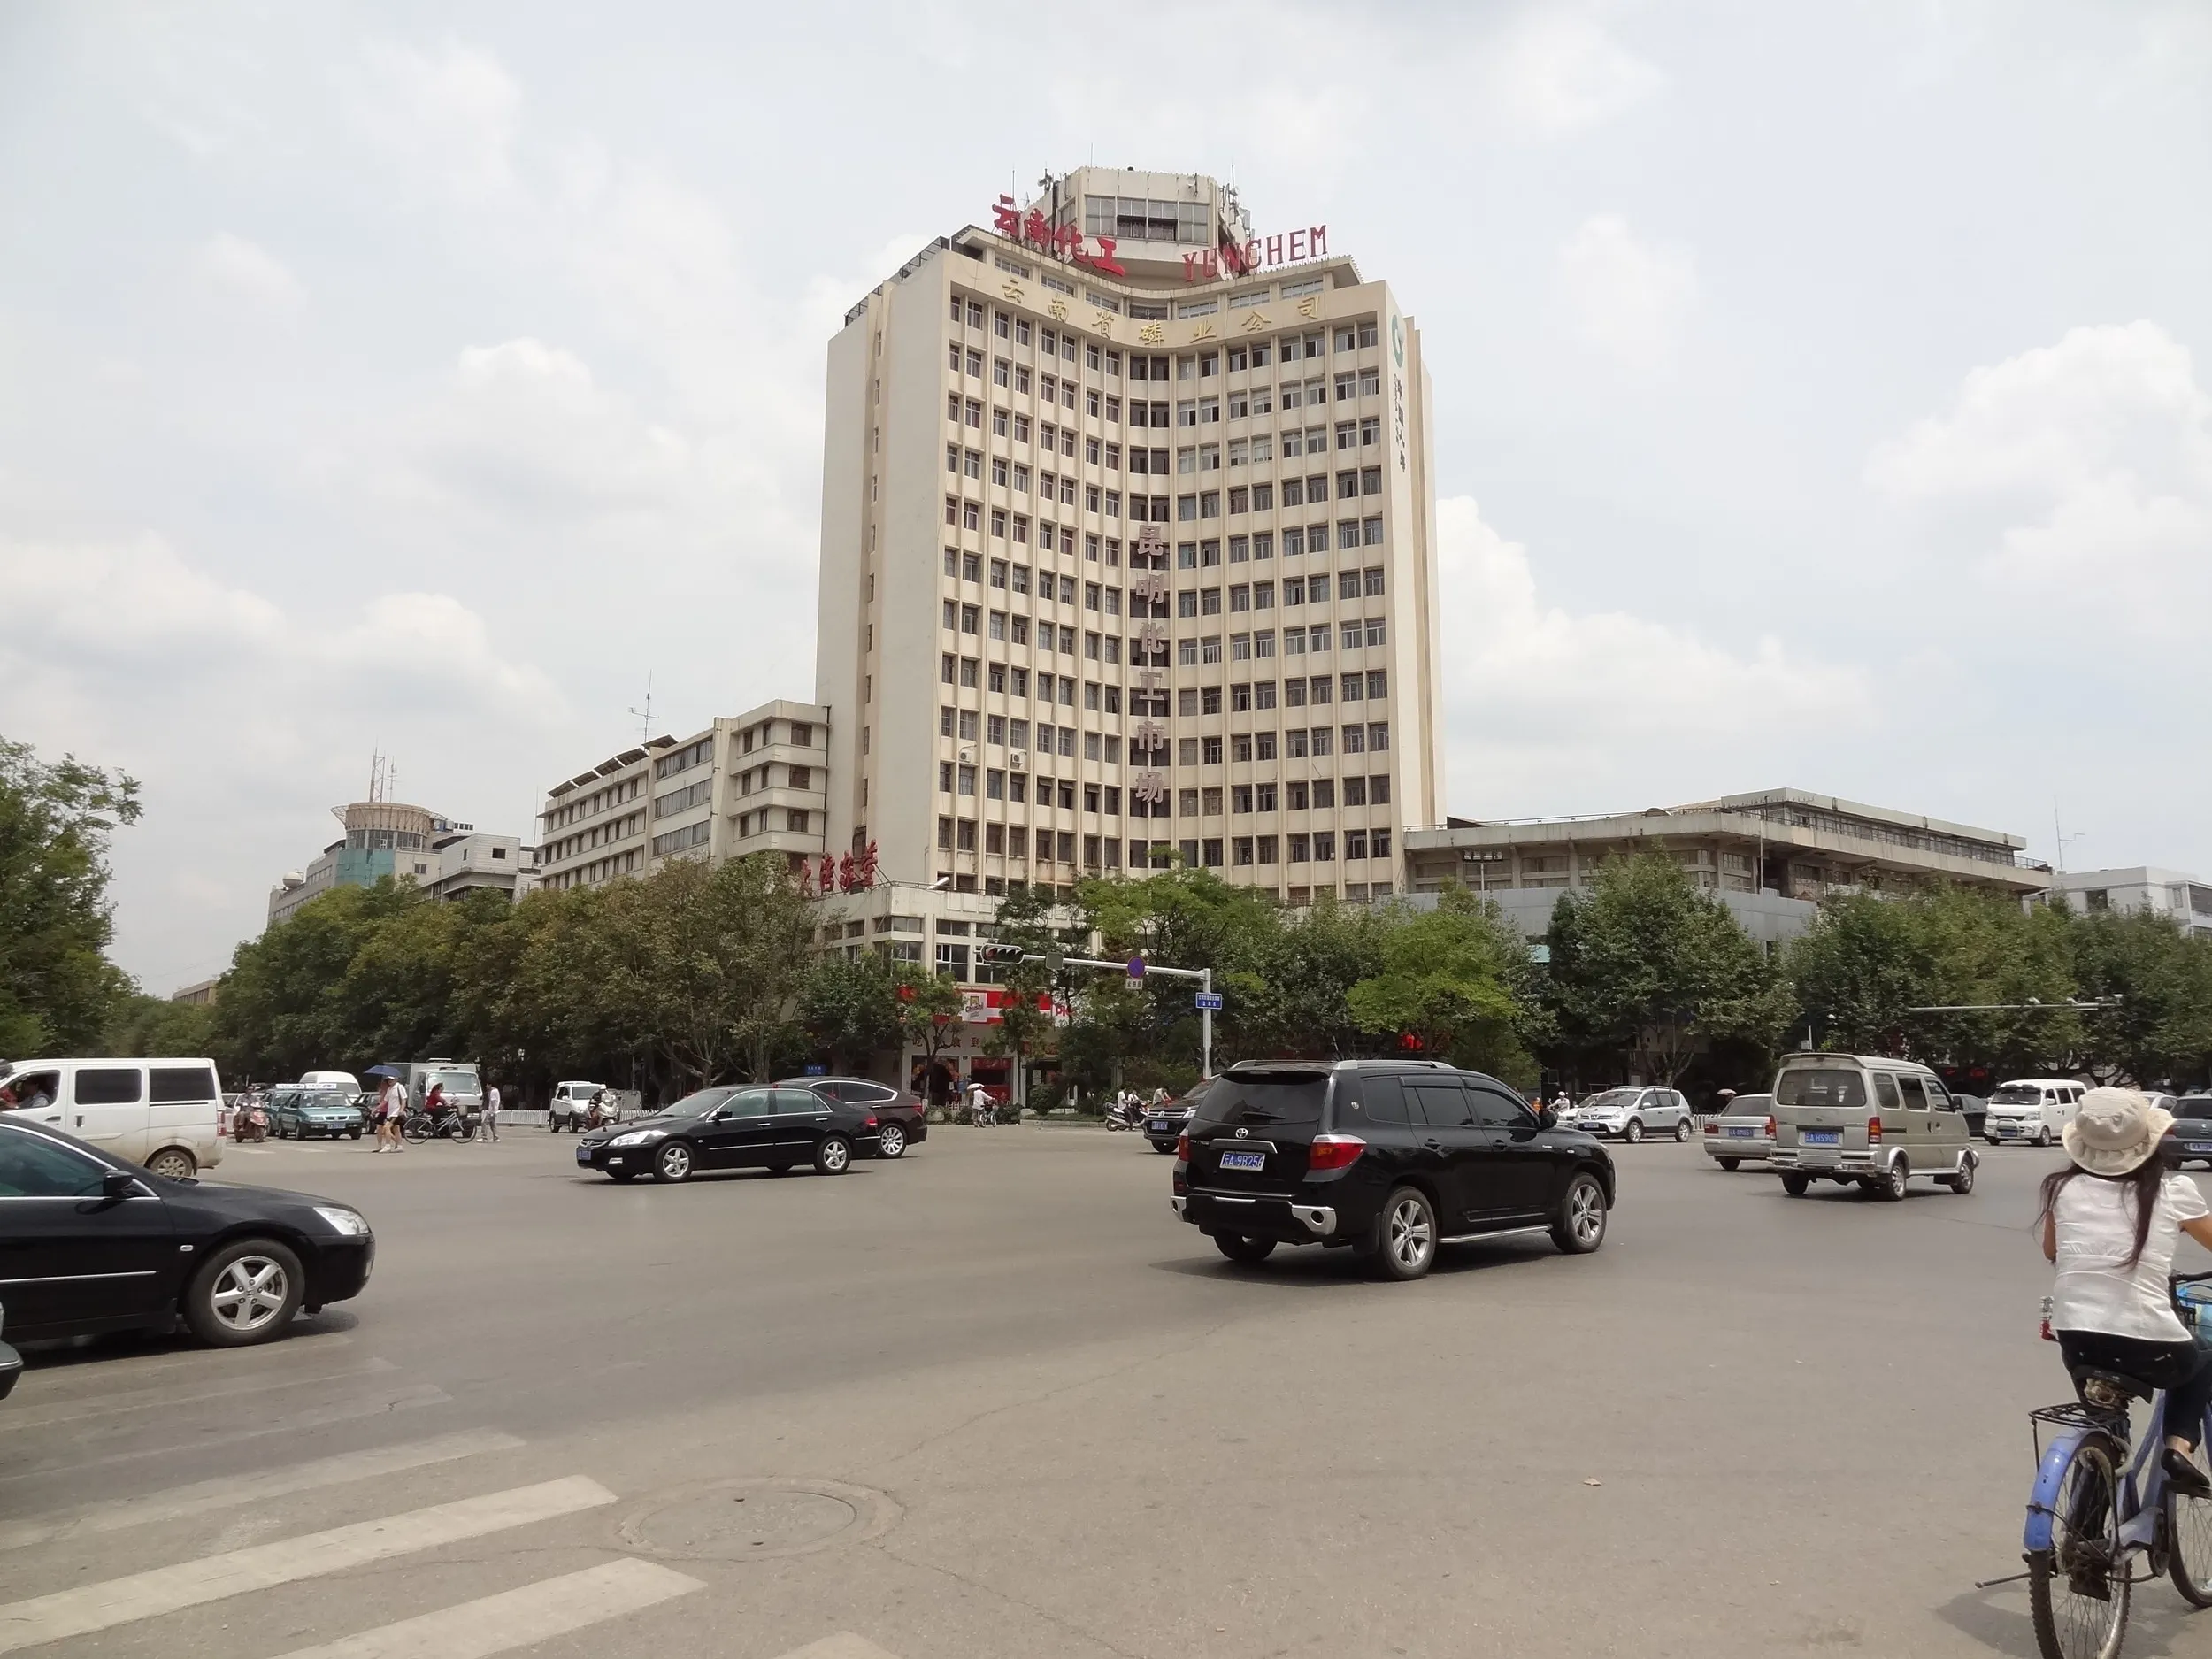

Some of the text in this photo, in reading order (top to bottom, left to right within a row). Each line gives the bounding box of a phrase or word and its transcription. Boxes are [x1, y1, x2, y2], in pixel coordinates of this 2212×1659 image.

[992, 193, 1126, 277] 云南化工
[1181, 224, 1328, 283] YUNCHEM
[1002, 279, 1322, 349] 云南省磷业公司
[1135, 524, 1165, 804] 昆明化工市场
